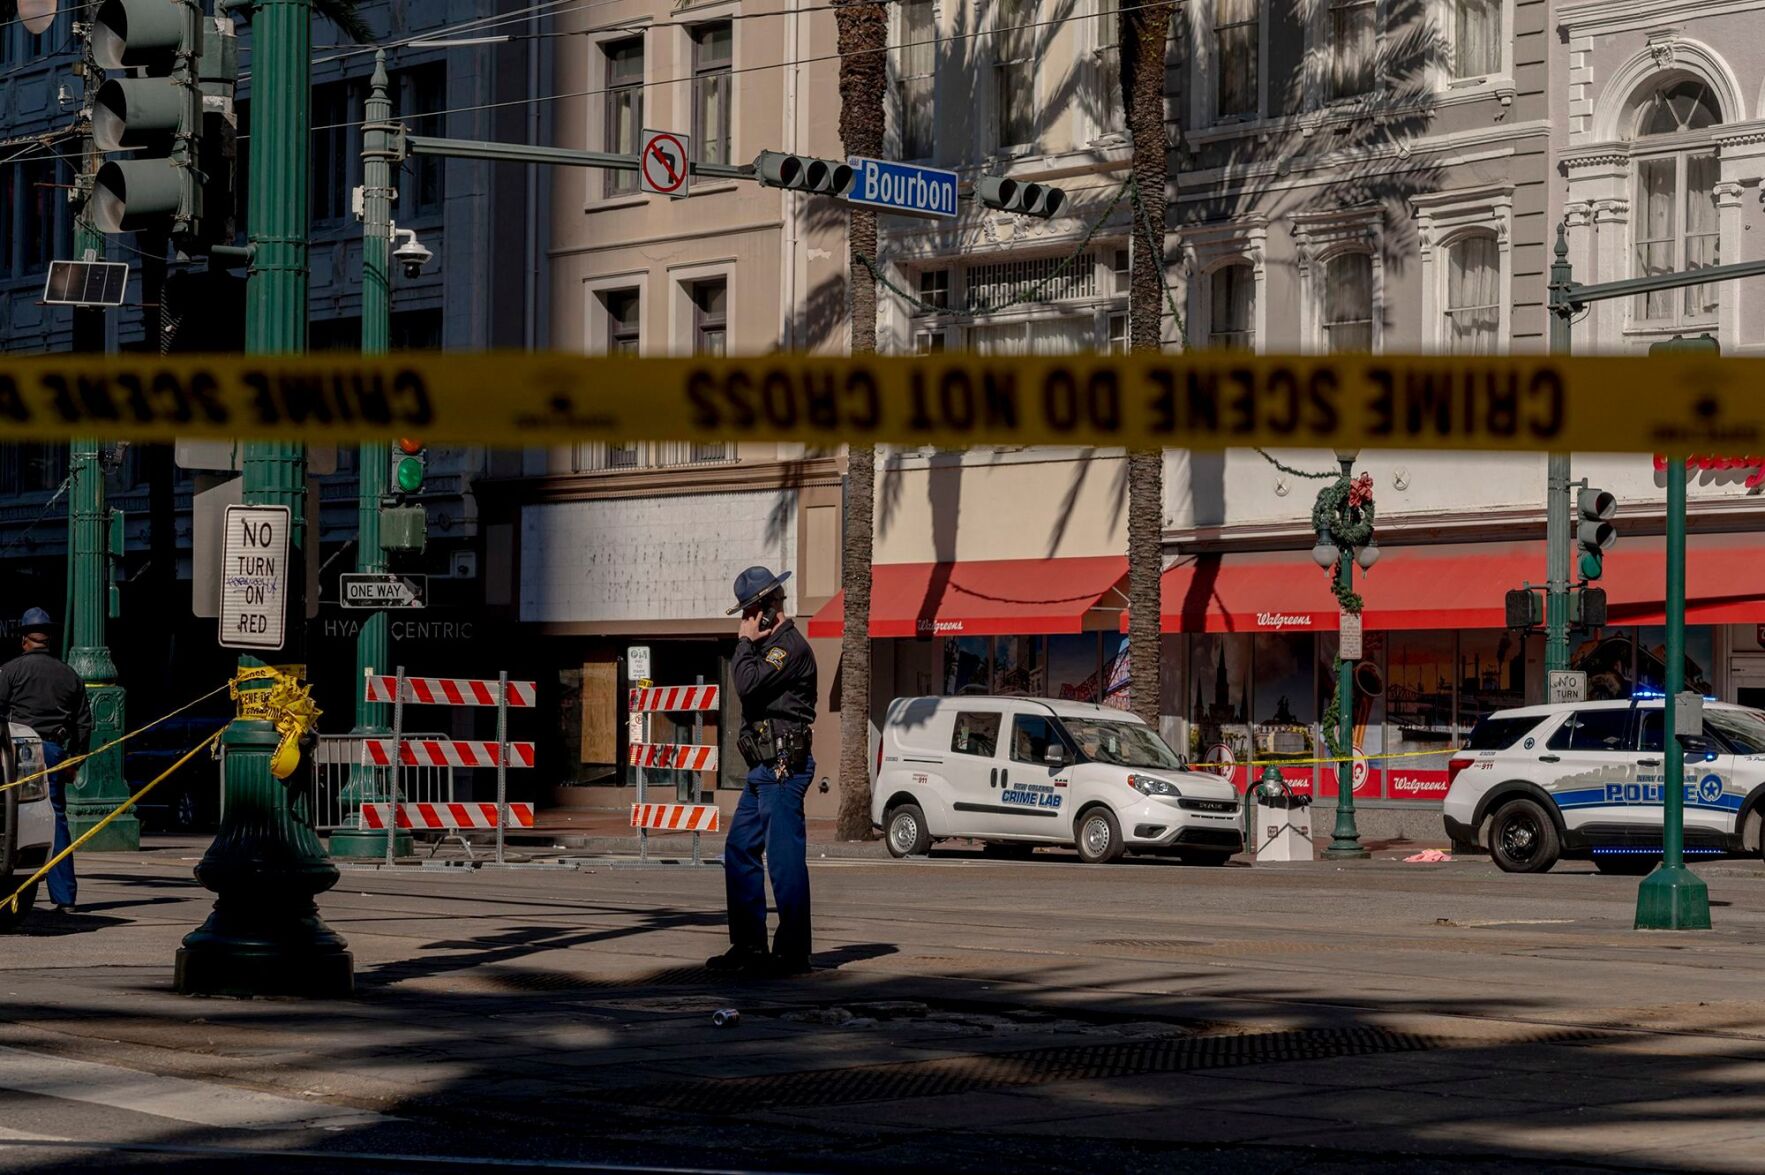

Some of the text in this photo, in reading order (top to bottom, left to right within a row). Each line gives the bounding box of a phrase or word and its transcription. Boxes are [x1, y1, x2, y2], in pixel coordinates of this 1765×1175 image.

[865, 162, 952, 212] Bourbon
[40, 371, 230, 424] SCENE
[241, 370, 435, 425] CRIME
[685, 366, 1566, 438] CRIME SCENE DO NOT CROSS
[243, 522, 272, 547] NO
[238, 557, 275, 576] TURN
[245, 585, 264, 604] ON
[350, 585, 402, 598] ONE WAY
[240, 614, 267, 633] RED
[391, 621, 473, 640] CENTRIC
[917, 619, 964, 634] Walgreens
[1257, 612, 1312, 630] Walgreens
[1558, 677, 1577, 688] NO
[1557, 690, 1578, 699] TURN
[1393, 777, 1448, 795] Walgreens
[1604, 783, 1699, 804] POLIE
[1002, 790, 1063, 808] CRIME LAB
